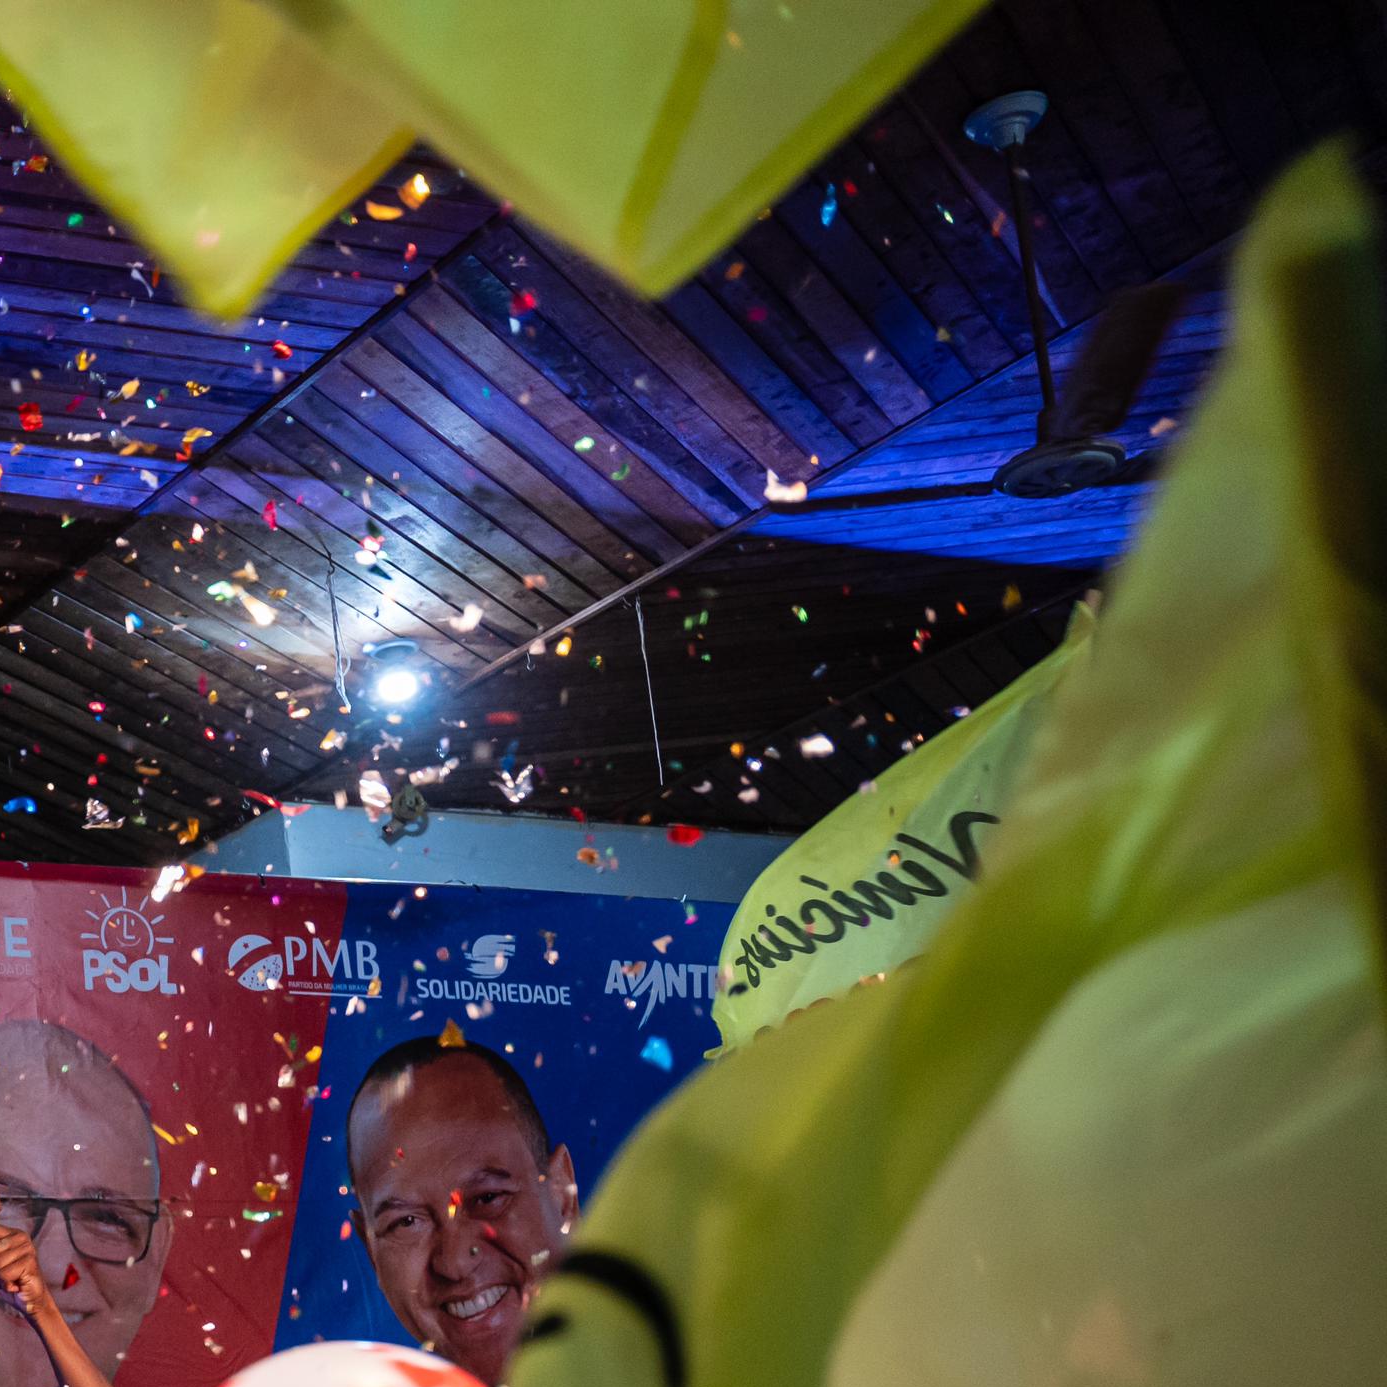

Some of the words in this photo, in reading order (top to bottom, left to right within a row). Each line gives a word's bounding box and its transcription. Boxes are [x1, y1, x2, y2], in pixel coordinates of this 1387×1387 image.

[83, 950, 178, 995] PSOL
[284, 936, 380, 980] PMB
[416, 978, 572, 1006] SOLIDARIEDADE
